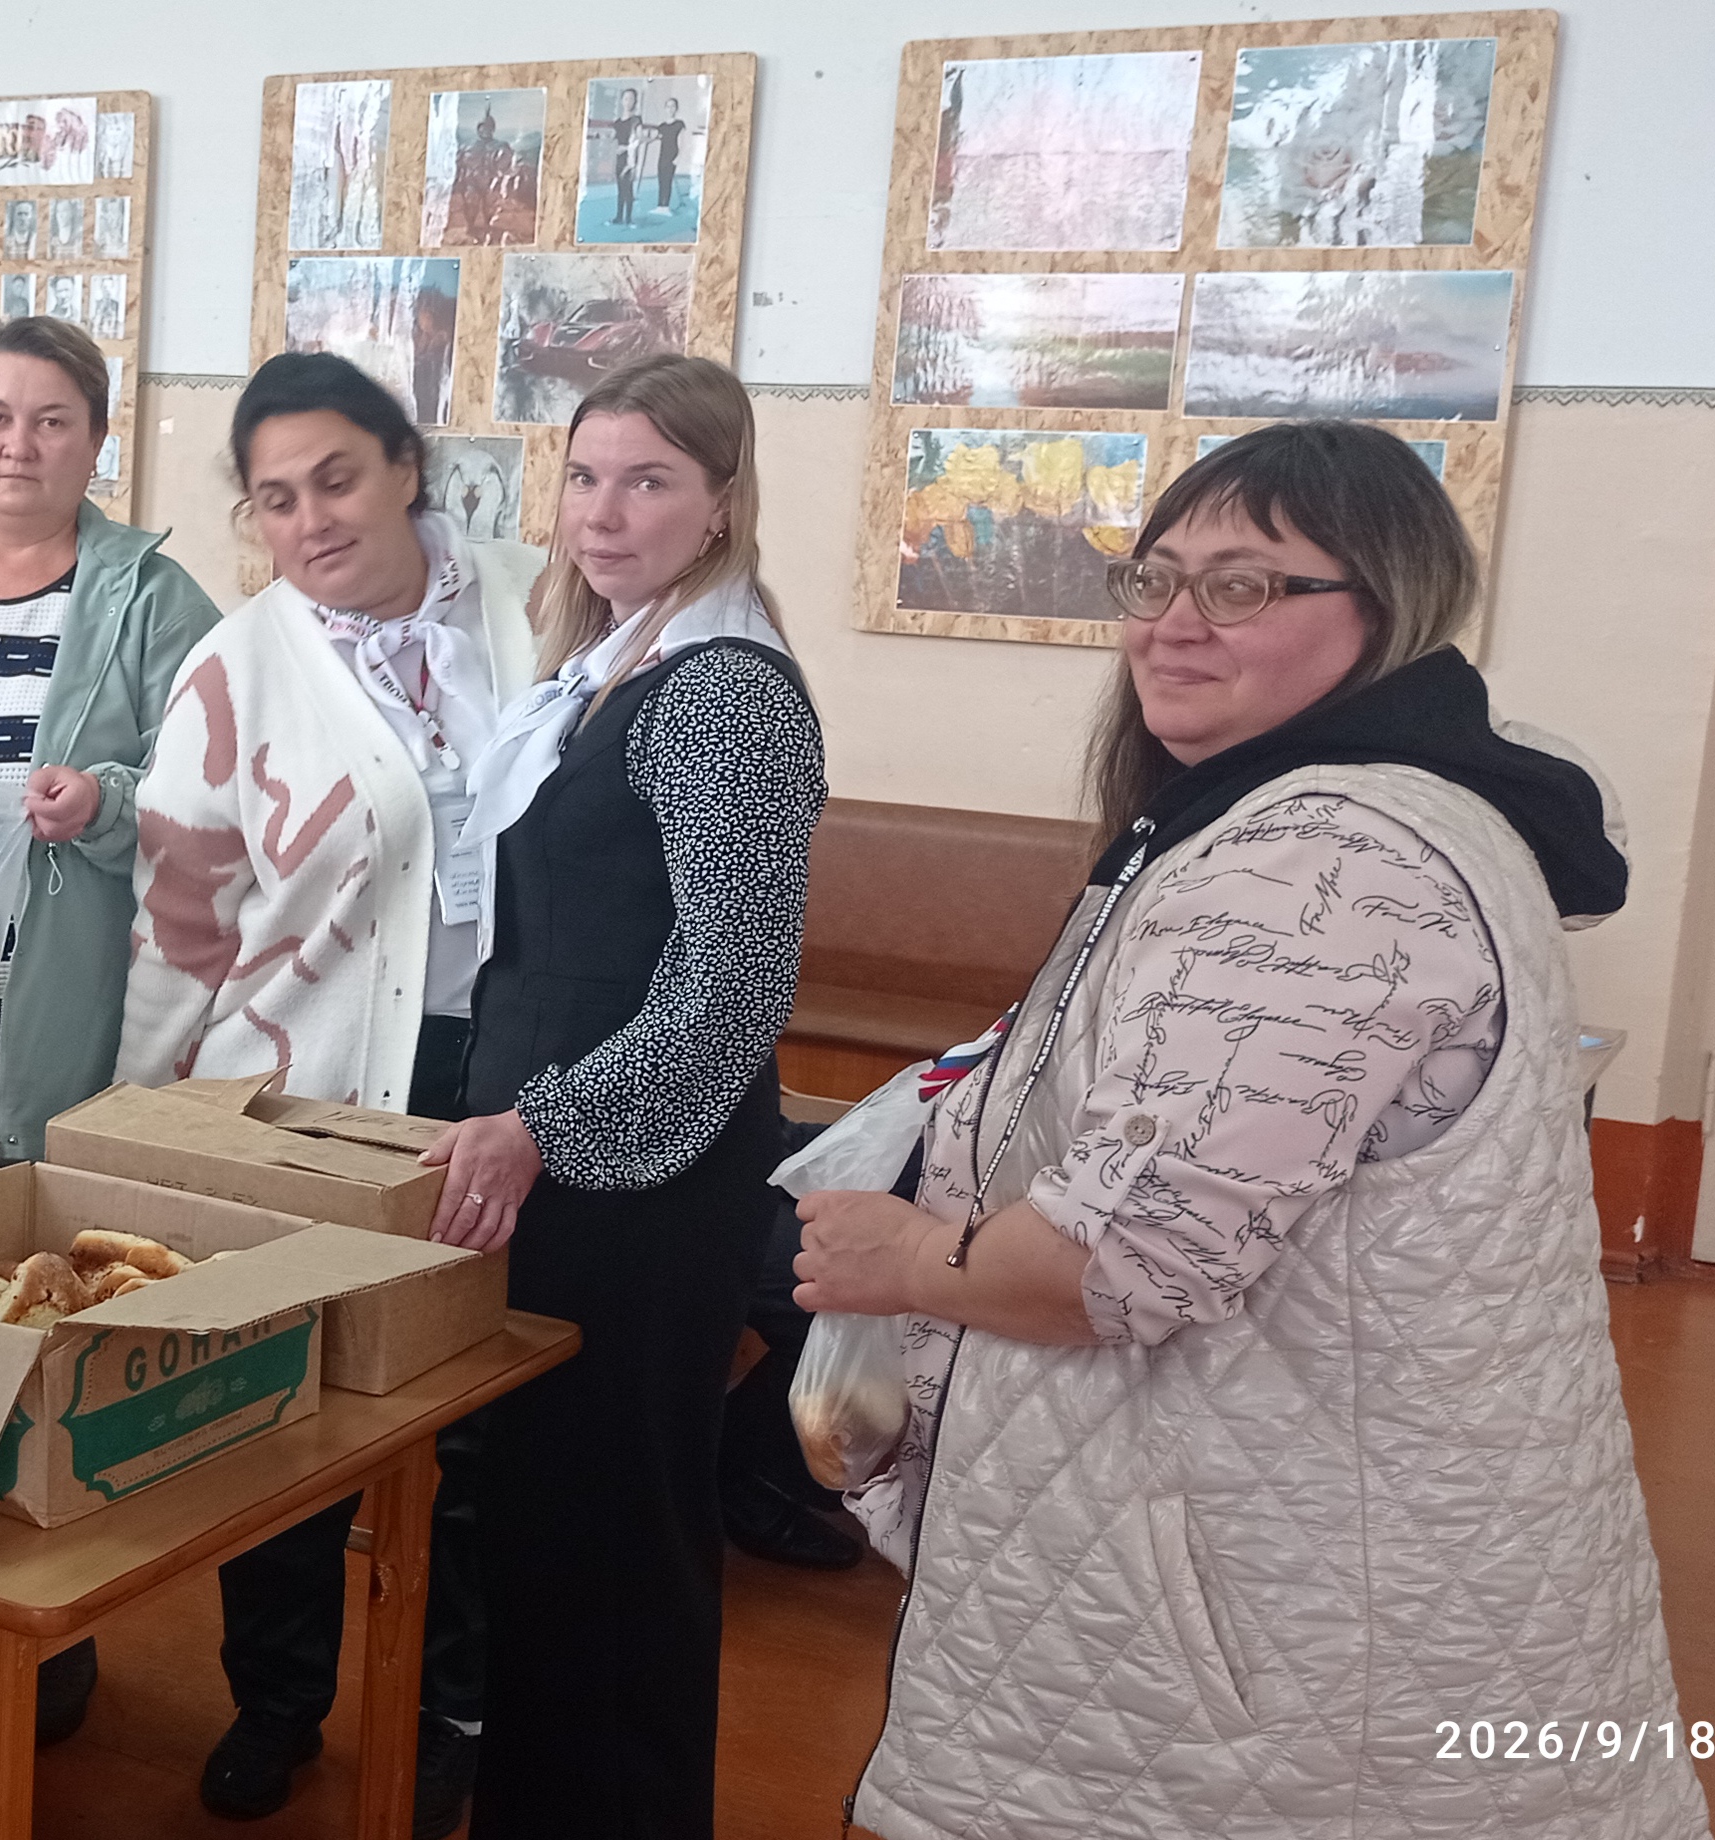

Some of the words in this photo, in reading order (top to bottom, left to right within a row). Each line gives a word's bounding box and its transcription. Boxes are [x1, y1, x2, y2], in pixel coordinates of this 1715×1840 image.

[1087, 884, 1124, 944] FASHION
[1058, 947, 1091, 1008] FASHION
[1033, 1011, 1063, 1072] FASHION
[1006, 1075, 1036, 1136] FASHION
